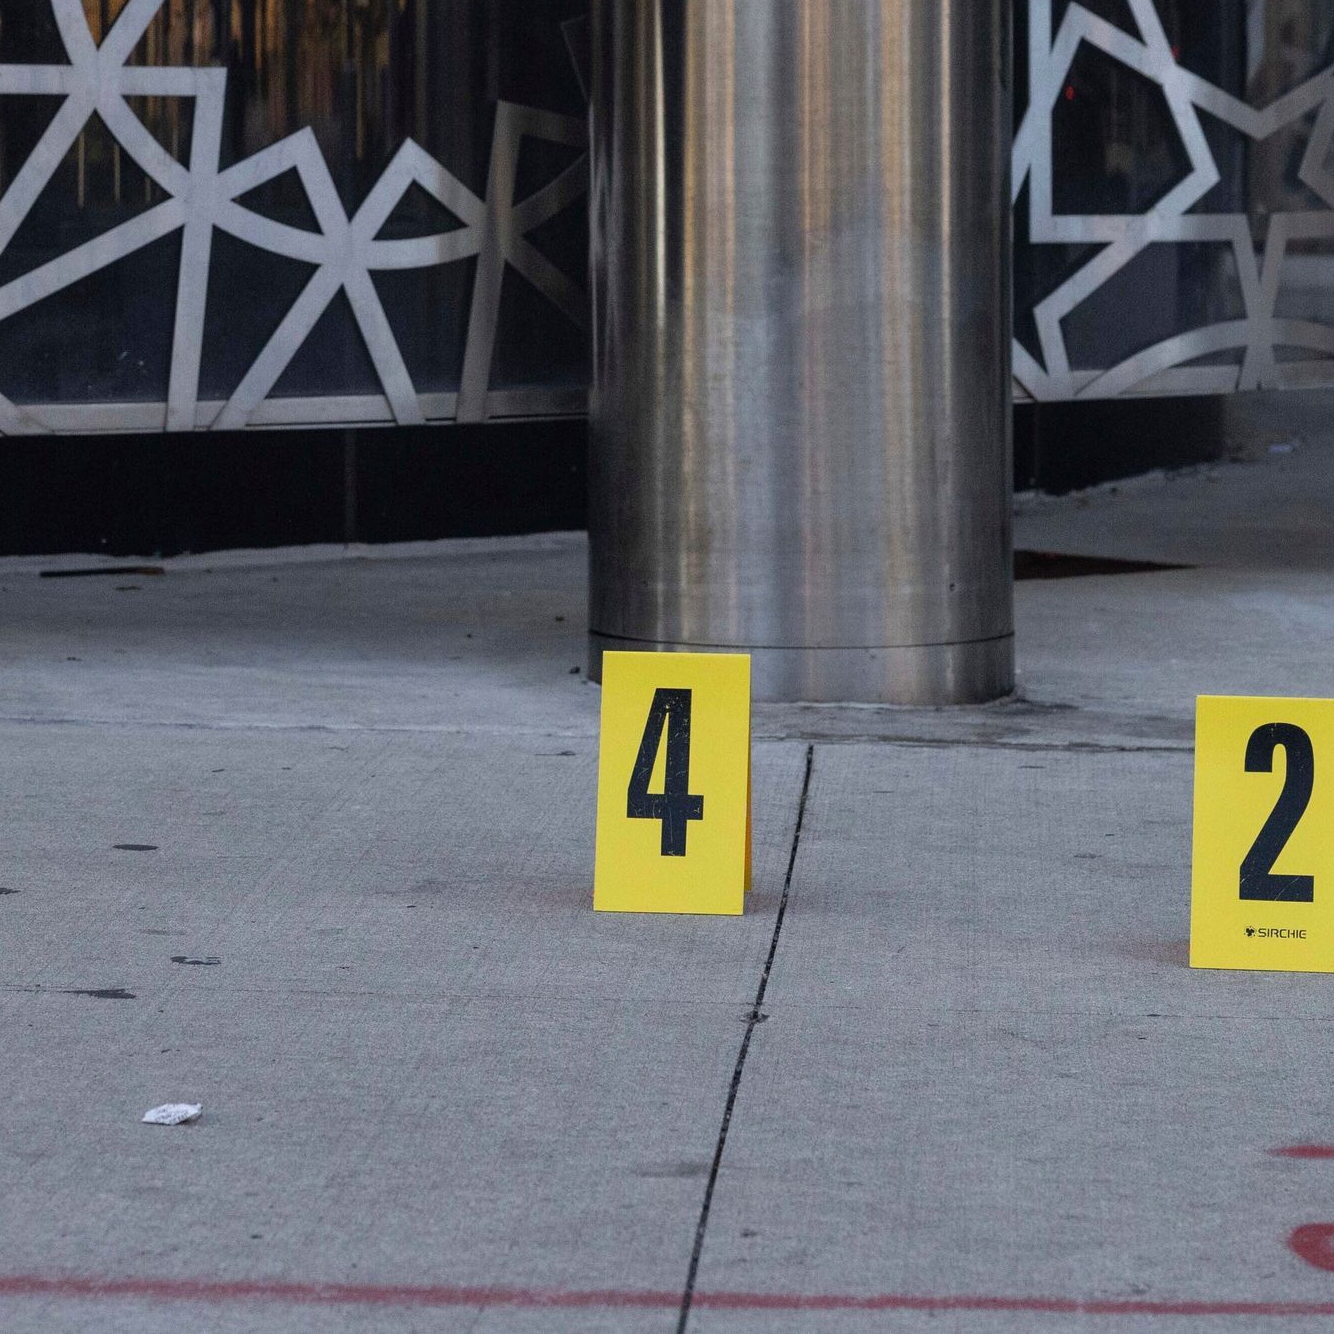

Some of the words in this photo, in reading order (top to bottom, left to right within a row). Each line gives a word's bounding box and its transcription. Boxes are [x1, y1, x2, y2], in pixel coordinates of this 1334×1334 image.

[626, 688, 703, 857] 4
[1239, 721, 1315, 903] 2
[1257, 927, 1307, 940] SIRCHIE
